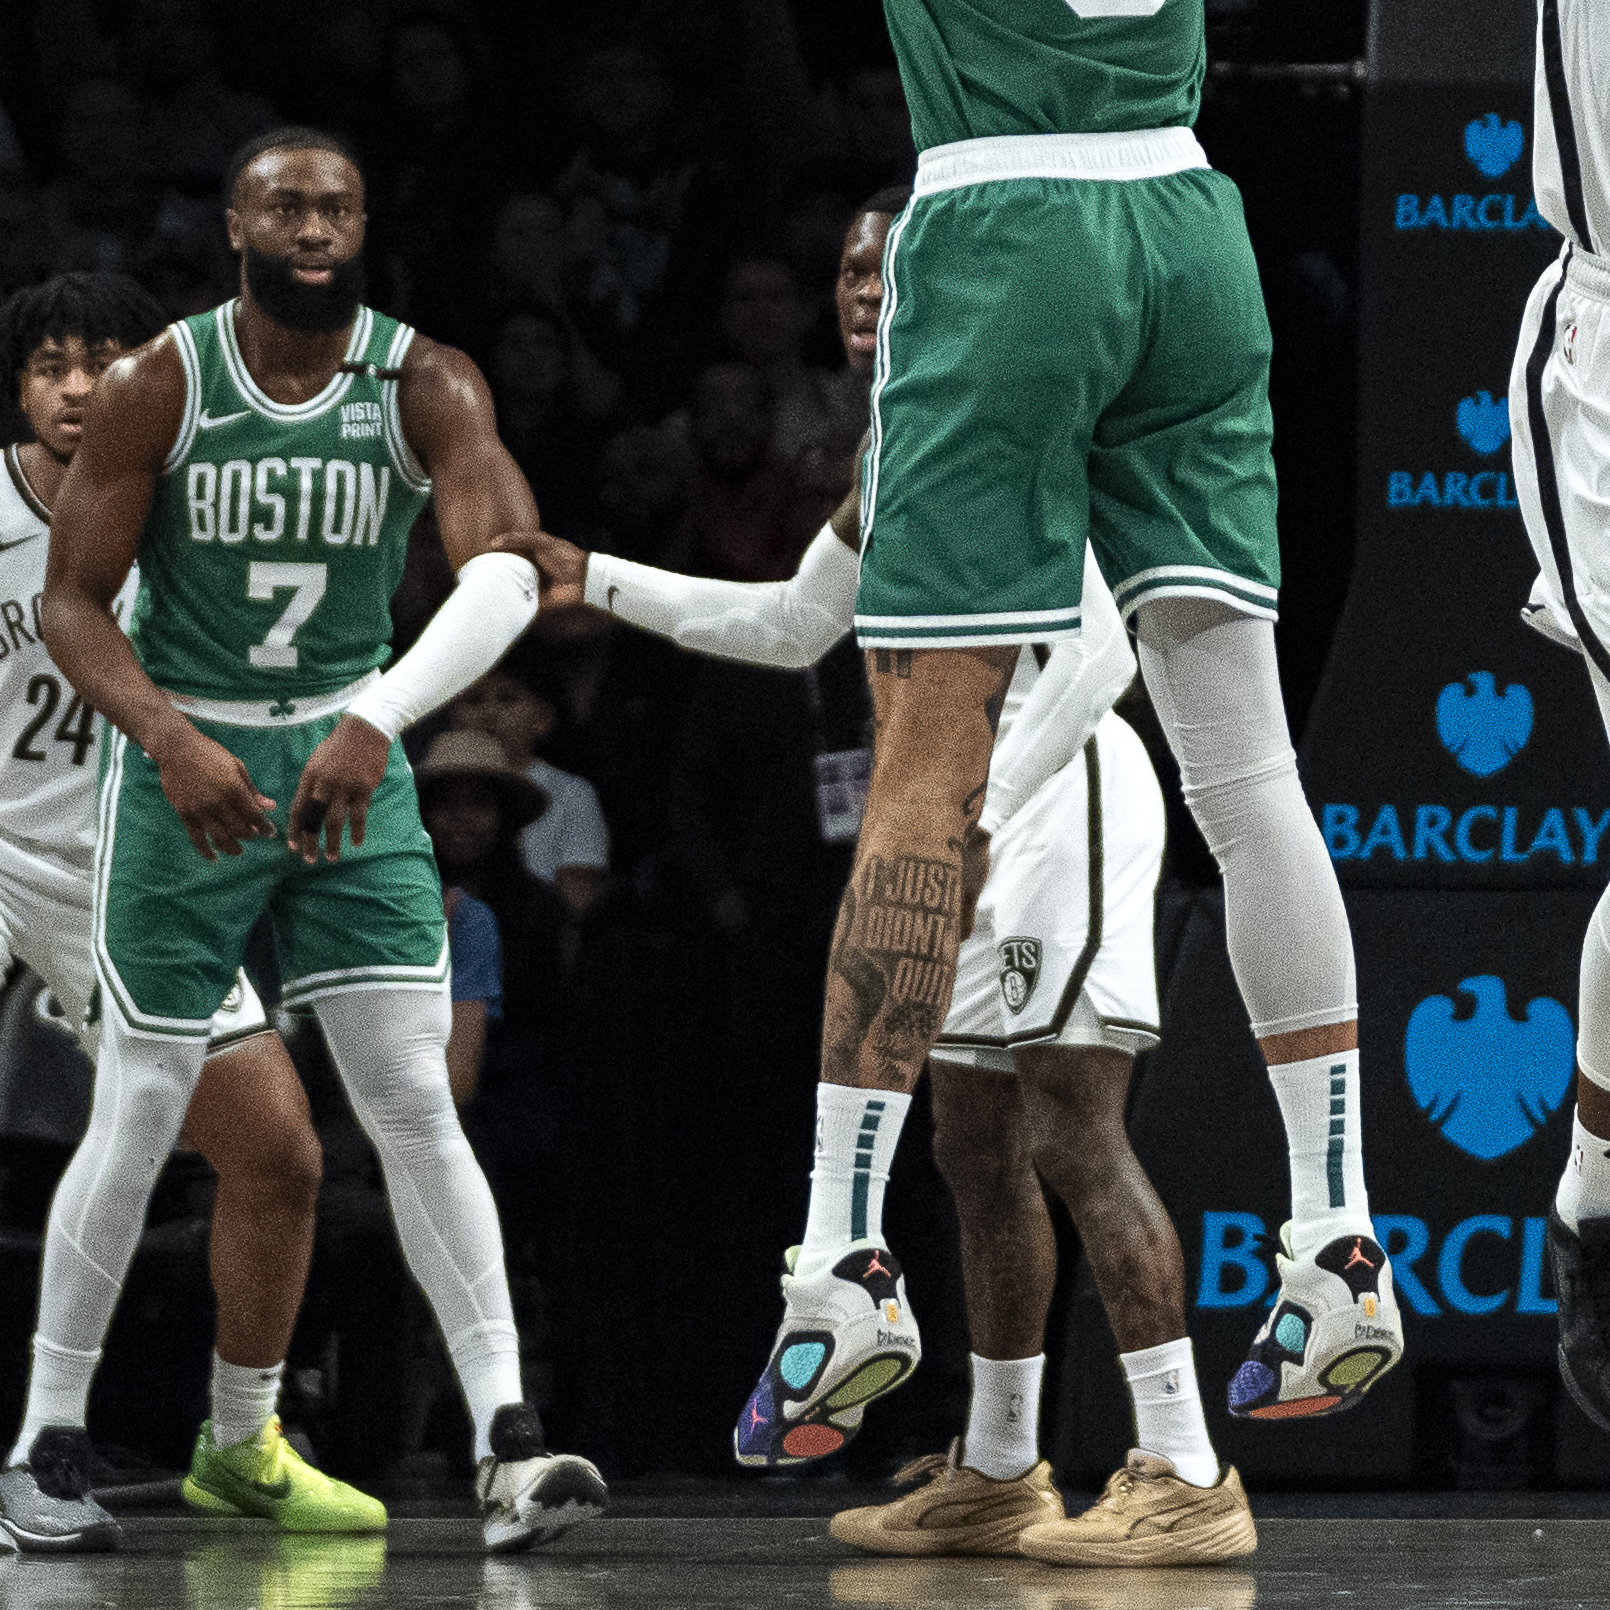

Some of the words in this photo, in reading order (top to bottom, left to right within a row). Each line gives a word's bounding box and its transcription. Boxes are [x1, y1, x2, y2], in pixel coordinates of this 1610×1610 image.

[340, 401, 382, 422] VISTA
[341, 422, 382, 440] PRINT
[187, 456, 391, 546] BOSTON
[1387, 470, 1518, 509] BARCL
[246, 561, 328, 668] 7
[12, 672, 95, 767] 24
